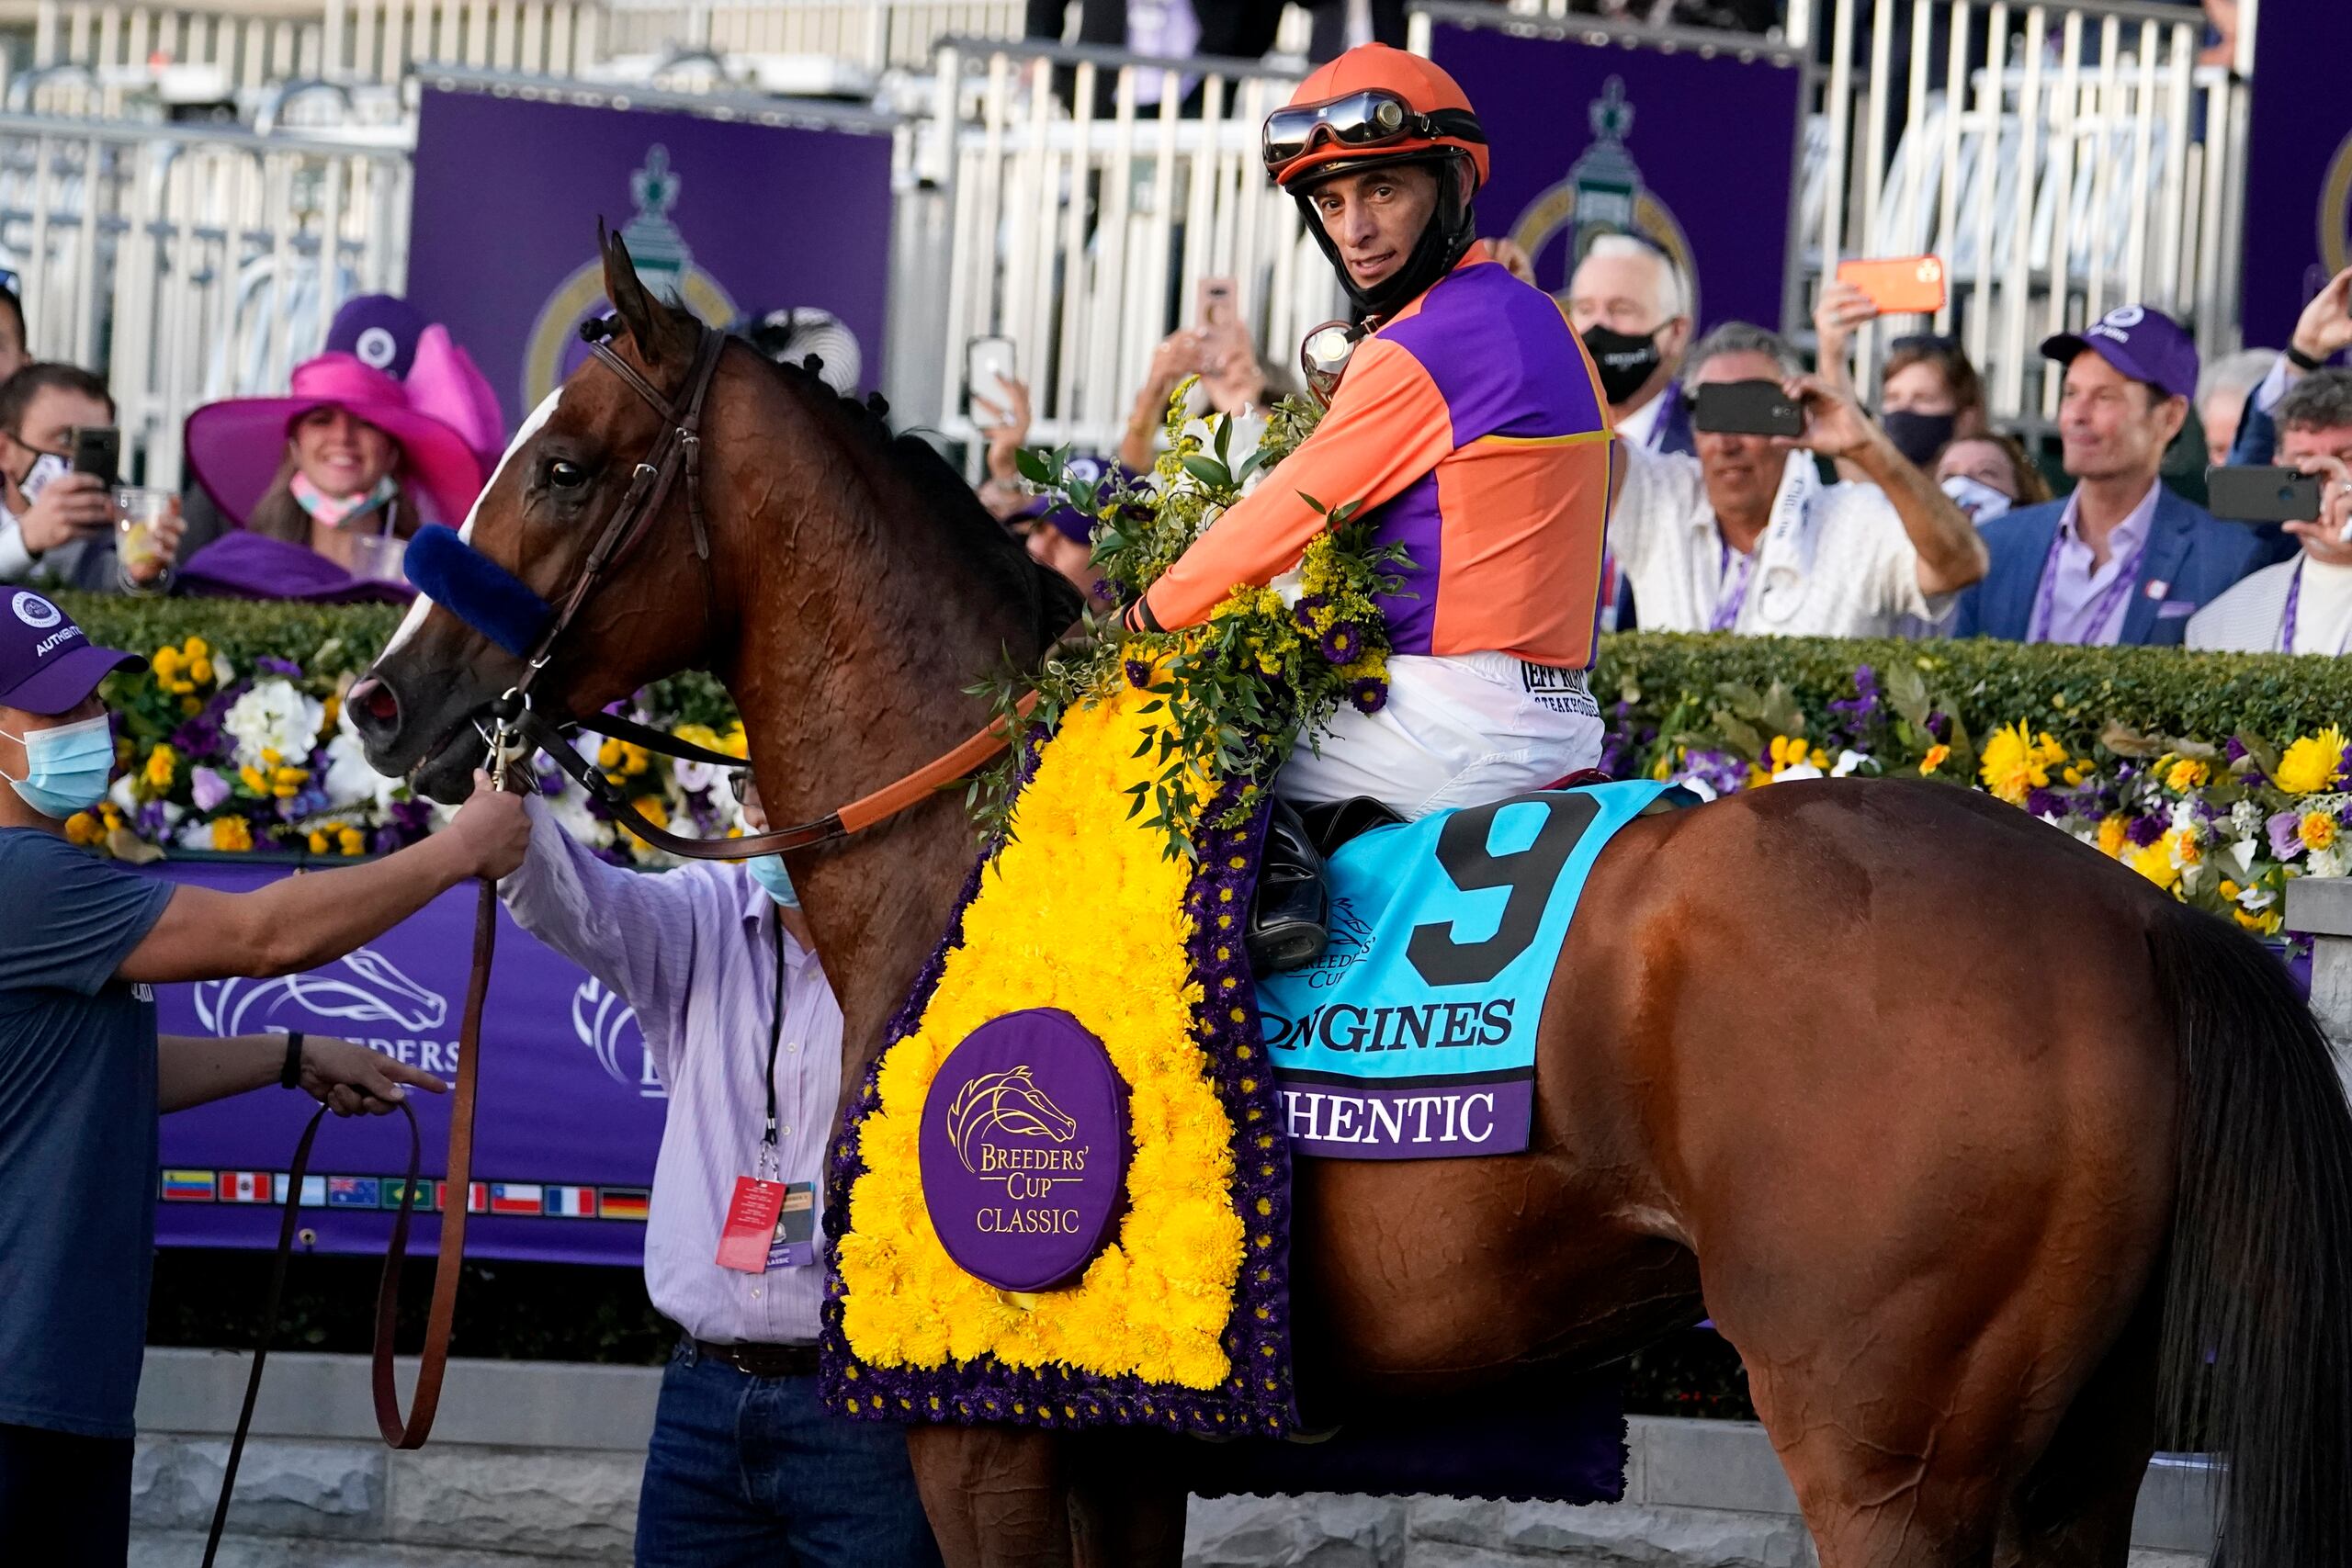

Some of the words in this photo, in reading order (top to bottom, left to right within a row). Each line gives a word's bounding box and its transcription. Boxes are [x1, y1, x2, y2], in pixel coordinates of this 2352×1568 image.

[1521, 660, 1555, 694] JEFF
[1406, 792, 1601, 987] 9
[1261, 998, 1516, 1053] ONGINES
[1278, 1090, 1494, 1144] HENTIC
[980, 1143, 1089, 1172] BREEDERS'
[1007, 1172, 1052, 1201] CUP
[977, 1208, 1080, 1234] CLASSIC
